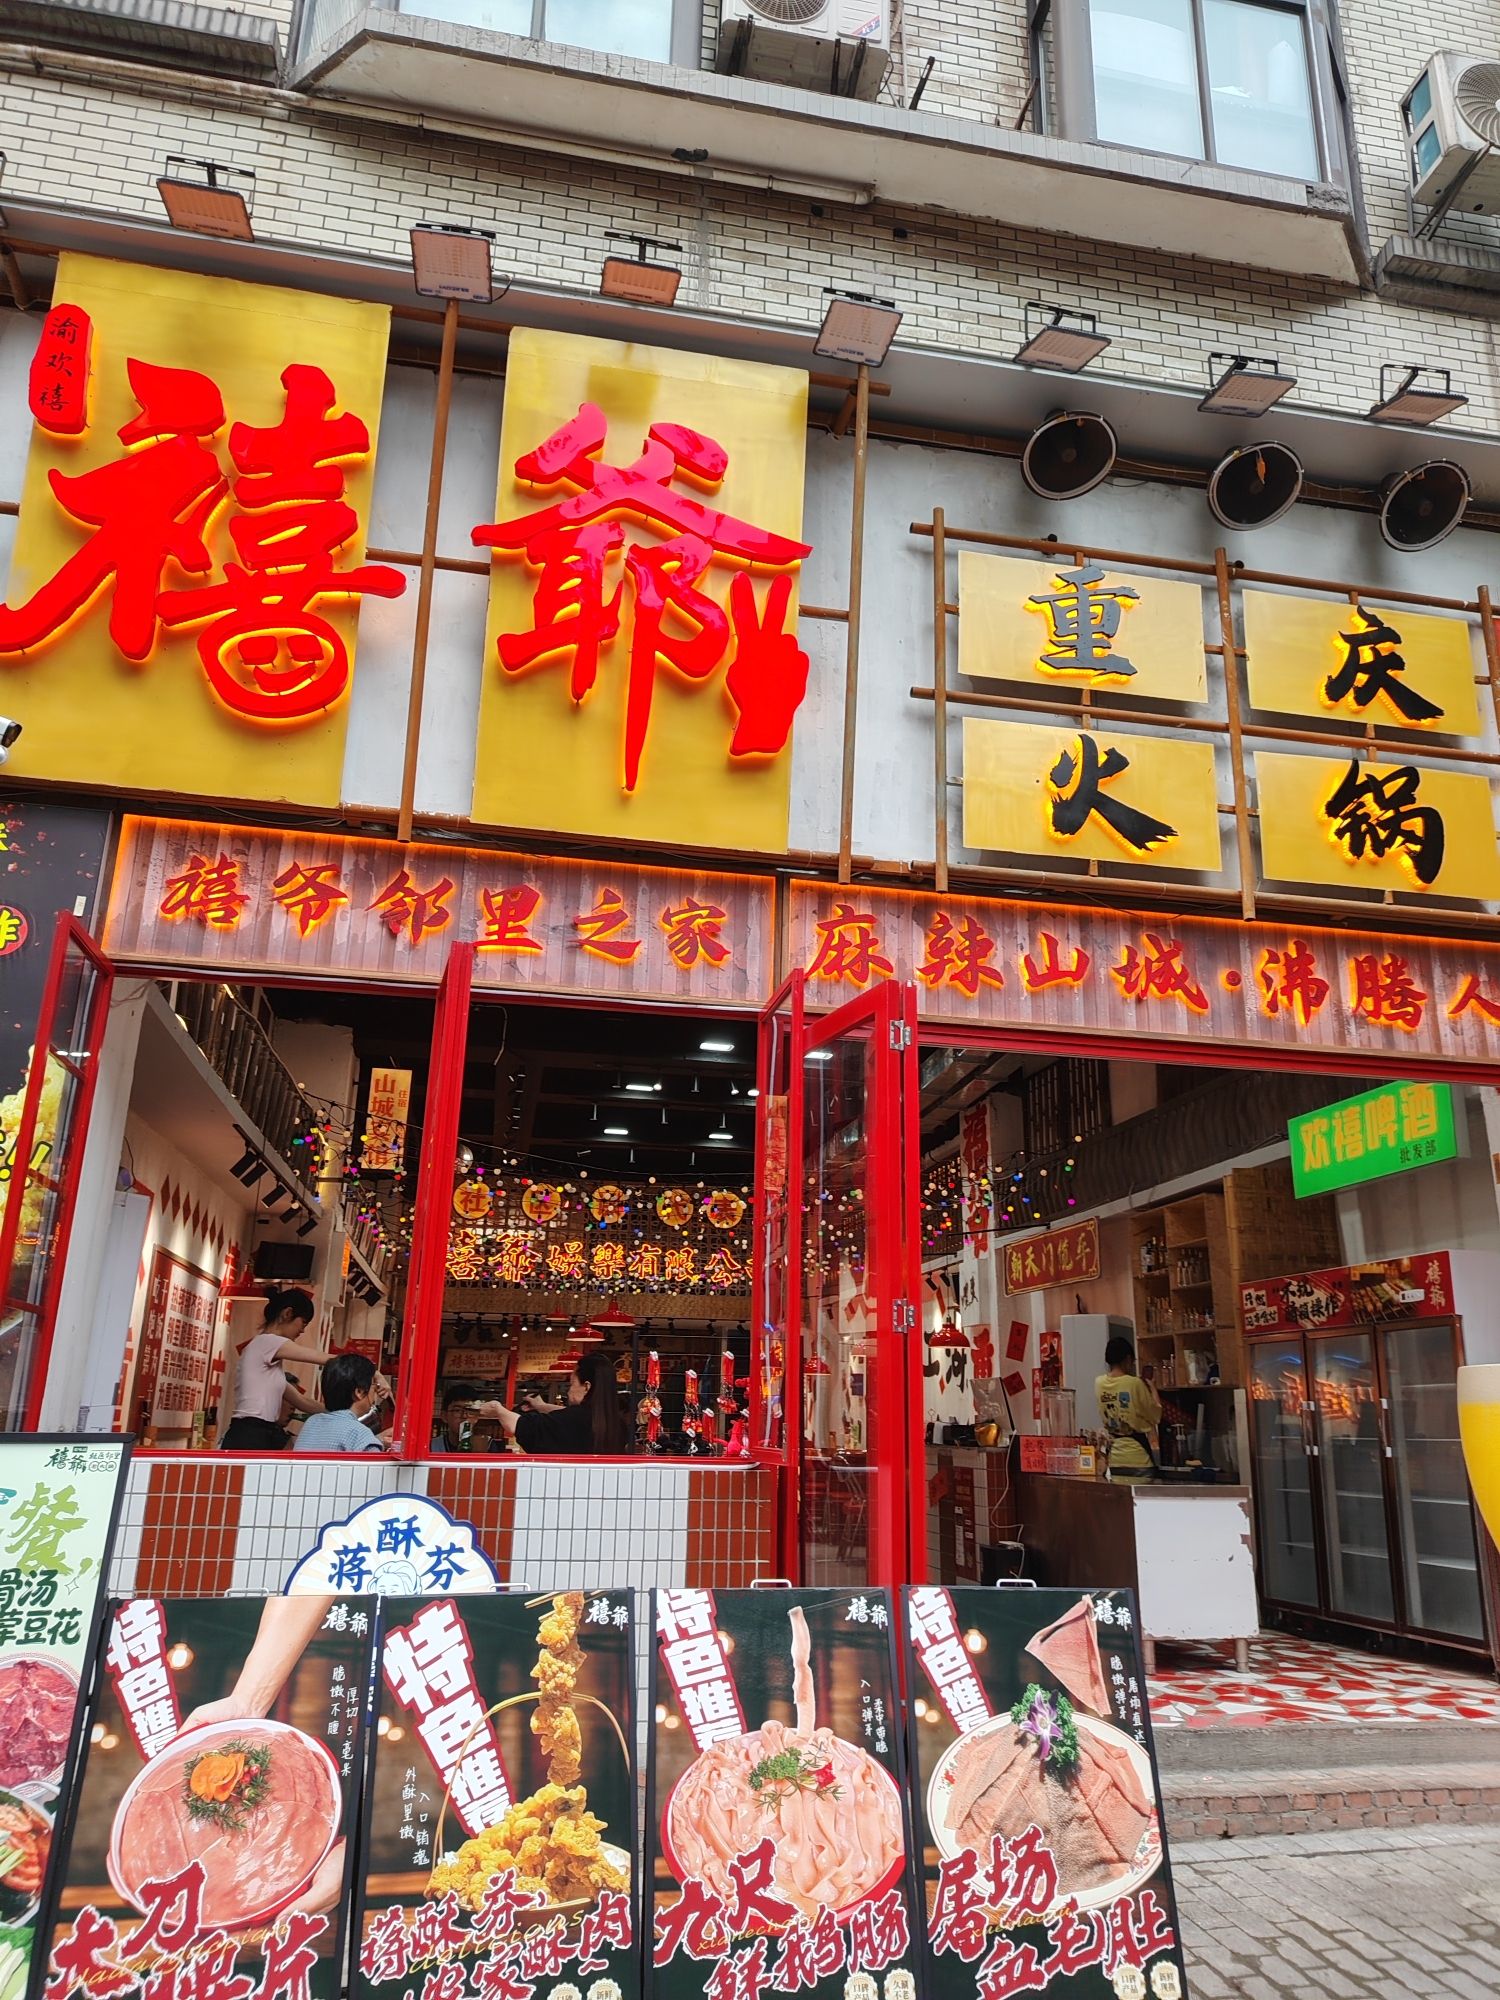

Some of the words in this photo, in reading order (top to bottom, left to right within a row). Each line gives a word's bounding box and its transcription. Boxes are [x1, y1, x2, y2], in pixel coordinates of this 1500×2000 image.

[46, 317, 80, 411] 渝欢禧
[1029, 565, 1444, 721] 重庆
[1049, 733, 1444, 885] 火锅
[161, 853, 733, 966] 禧爷邻里之家
[1300, 1085, 1438, 1173] 欢禧啤酒
[1400, 1139, 1438, 1165] 批发部
[328, 1514, 470, 1592] 蒋酥芬
[108, 1600, 178, 1758] 特色推荐
[655, 1589, 743, 1751] 特色推荐
[860, 1679, 874, 1737] 入口弹牙
[908, 1588, 990, 1734] 特色推荐
[1110, 1655, 1127, 1720] 脆嫩弹牙
[340, 1687, 360, 1777] 厚切5毫米
[383, 1601, 514, 1835] 特色推荐
[873, 1697, 889, 1754] 柔中带脆
[399, 1766, 417, 1840] 外酥里嫩
[411, 1792, 431, 1865] 入口销魂
[653, 1836, 803, 1970] 九尺
[927, 1823, 1060, 1963] 屠场
[974, 1889, 1176, 2000] 血毛肚
